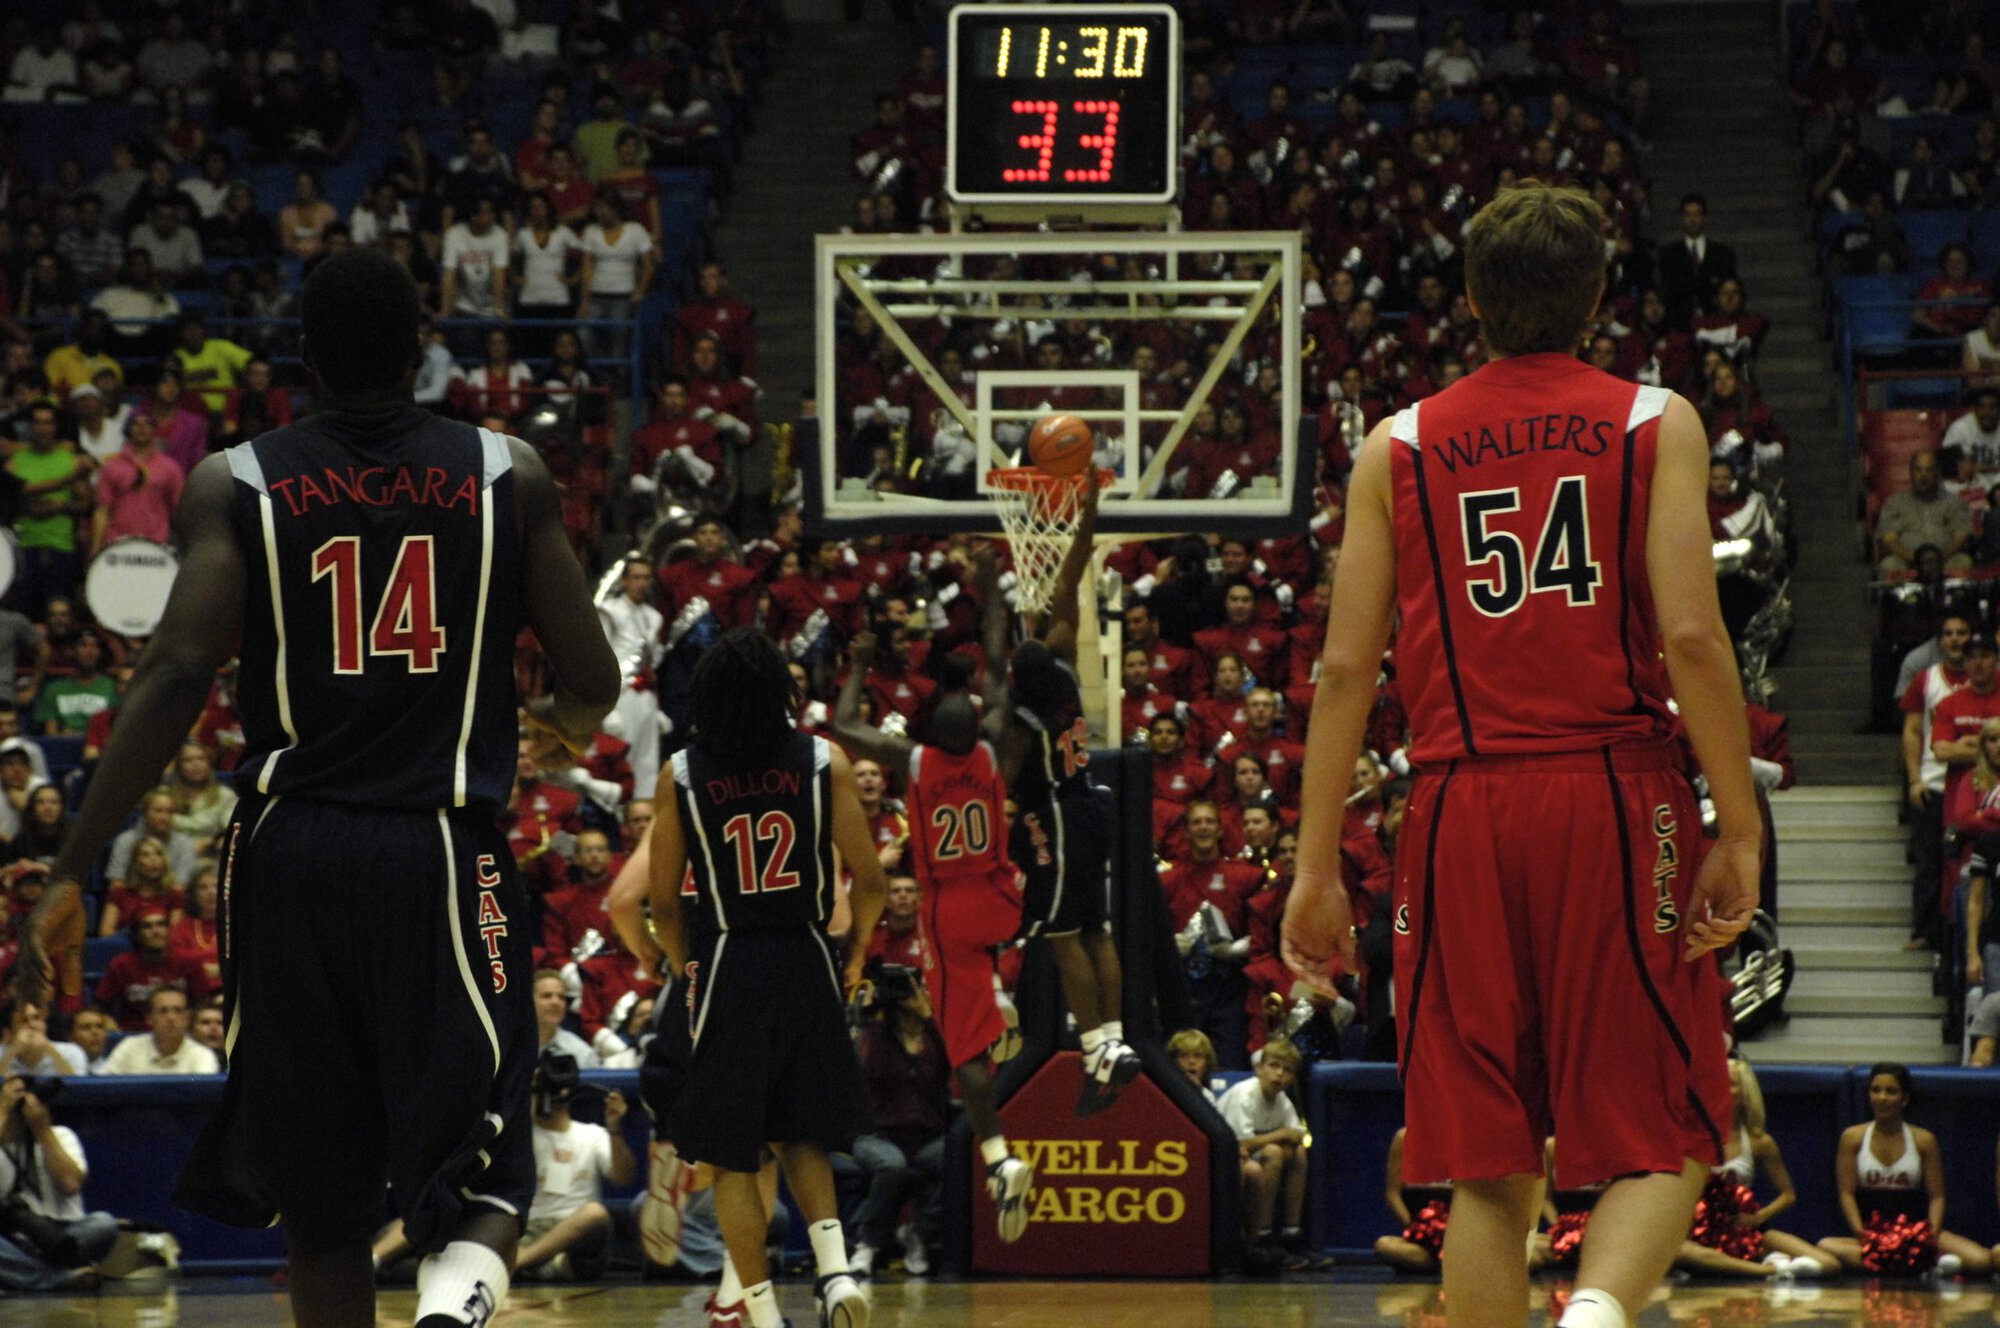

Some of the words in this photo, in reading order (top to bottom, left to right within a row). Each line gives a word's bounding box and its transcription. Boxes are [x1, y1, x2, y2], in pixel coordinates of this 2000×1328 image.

[997, 26, 1148, 79] 11:30
[1001, 100, 1121, 182] 33
[1432, 414, 1614, 473] WALTERS
[270, 465, 479, 517] TANGARA
[1458, 475, 1604, 619] 54
[311, 534, 447, 675] 14
[706, 768, 801, 806] DILLON
[722, 809, 801, 895] 12
[932, 799, 990, 862] 20
[1652, 803, 1680, 933] CATS
[475, 853, 508, 994] CATS
[1028, 1185, 1187, 1225] ARGO
